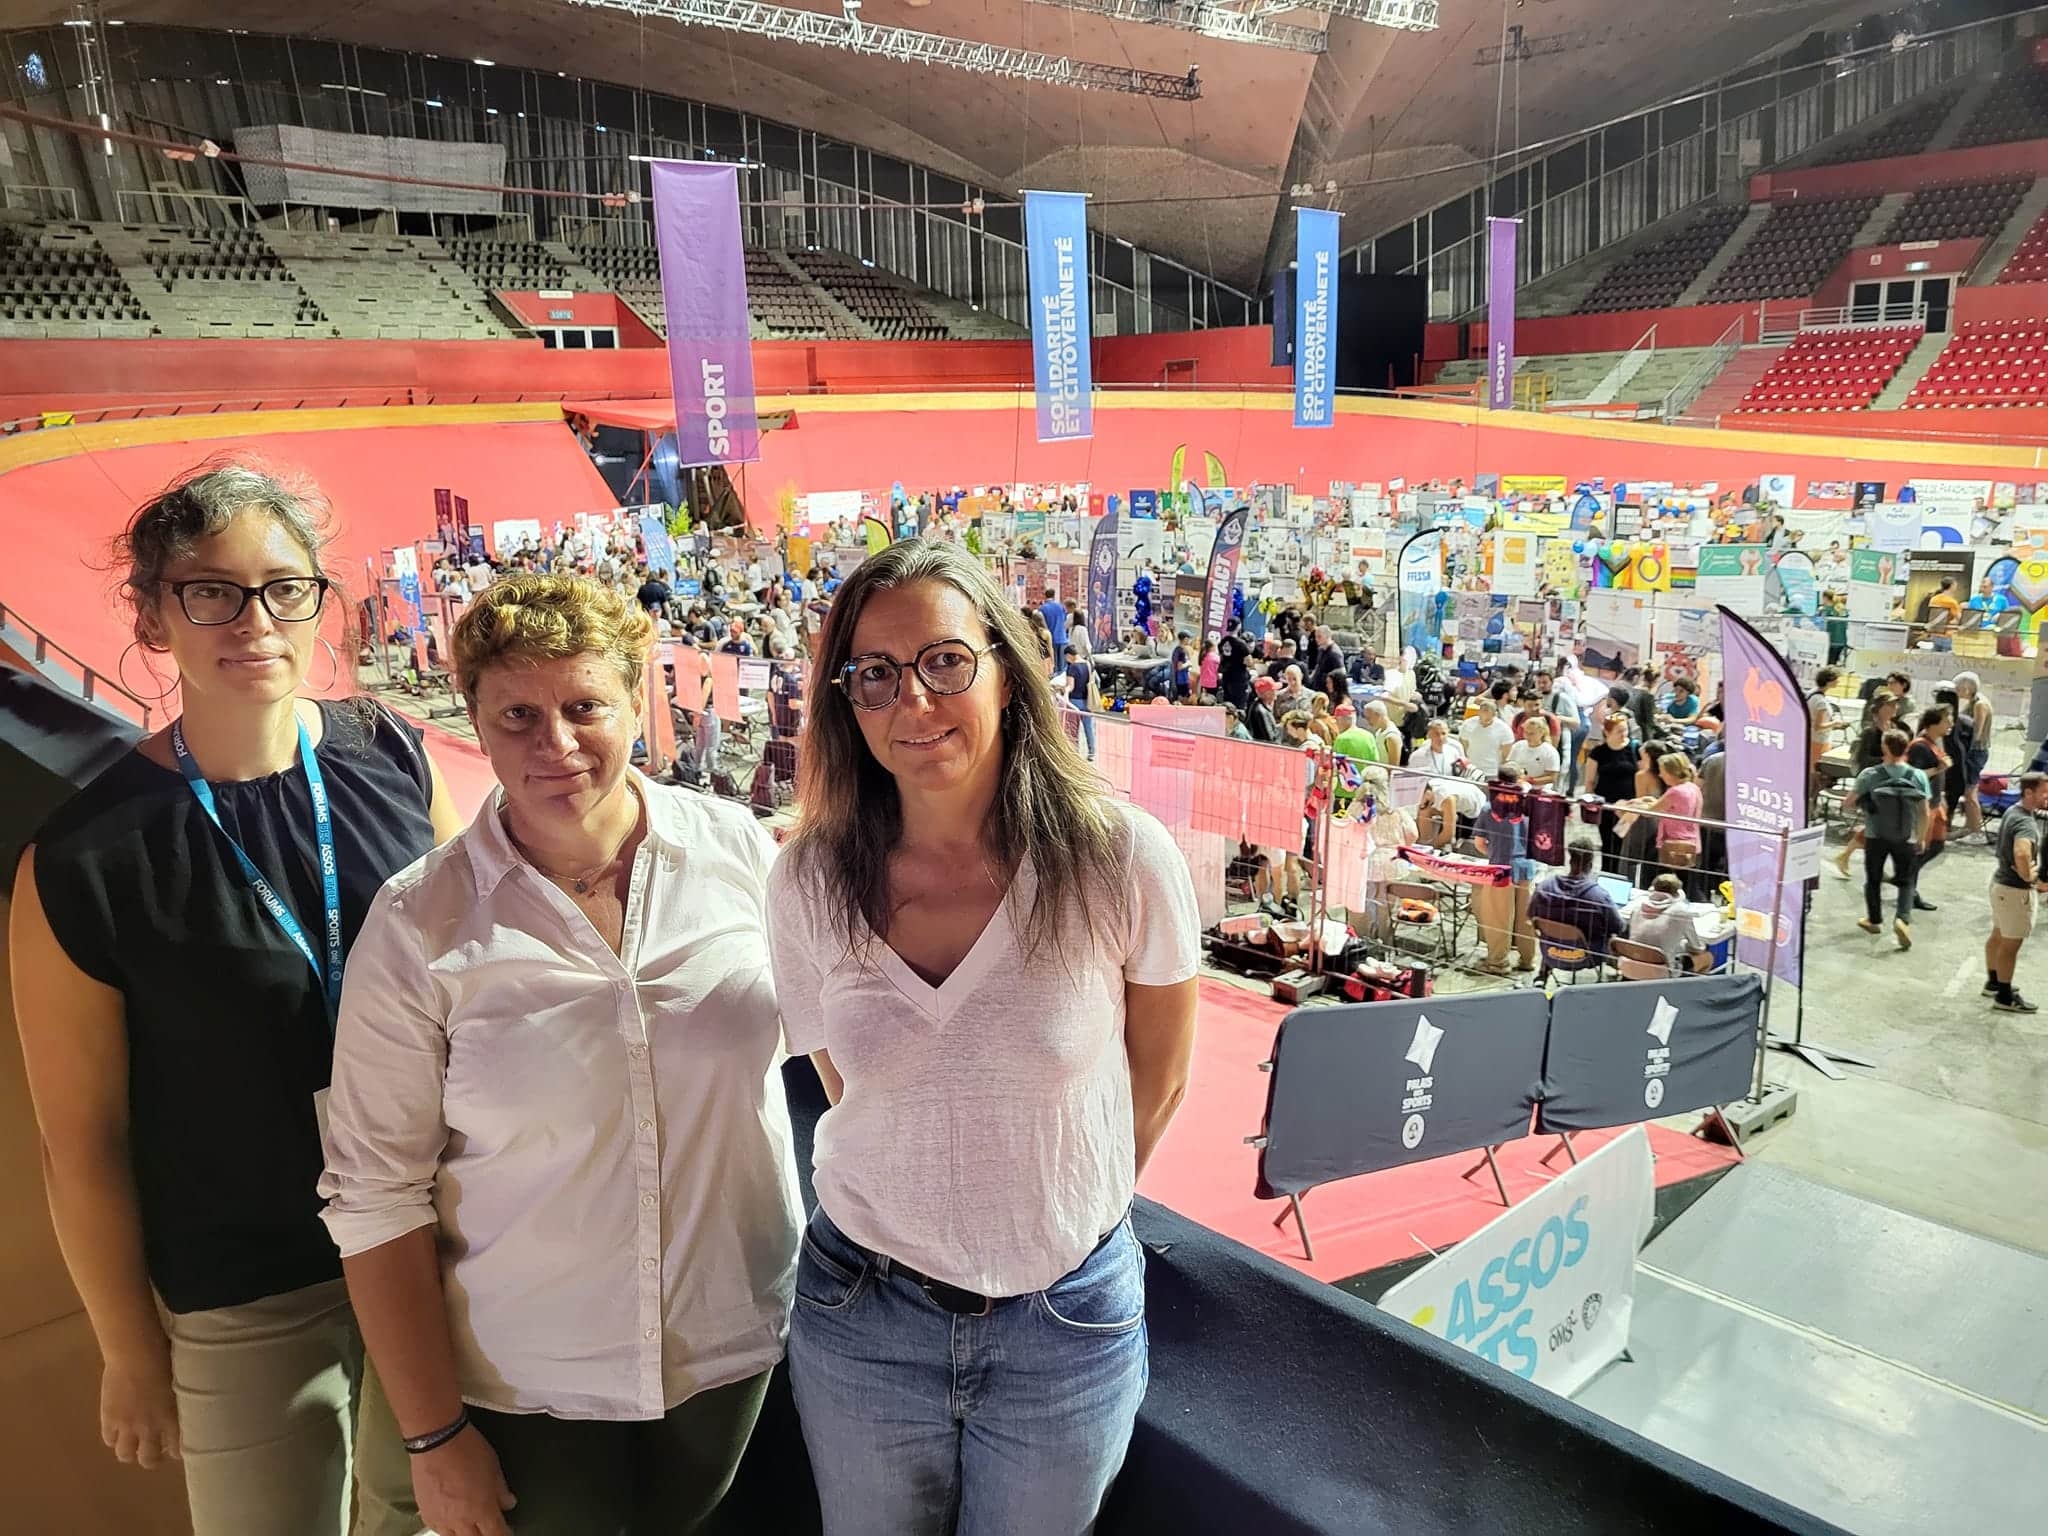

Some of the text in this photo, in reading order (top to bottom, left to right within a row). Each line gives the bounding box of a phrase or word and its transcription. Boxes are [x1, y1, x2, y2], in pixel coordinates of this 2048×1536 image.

[1042, 293, 1065, 435] SOLIDARITÉ
[1054, 236, 1081, 434] ET CITOYENNETÉ
[1303, 300, 1317, 421] SOLIDARITÉ
[1314, 250, 1329, 421] ET CITOYENNETÉ
[1495, 341, 1506, 403] SPORT
[702, 358, 730, 456] SPORT
[1208, 553, 1232, 628] IMPACT
[252, 879, 286, 918] FORUMS
[311, 782, 328, 823] FORUMS
[321, 843, 335, 876] ASSOS
[328, 908, 340, 948] SPORTS
[1402, 1094, 1433, 1110] SPORTS
[1446, 1195, 1589, 1344] ASSOS
